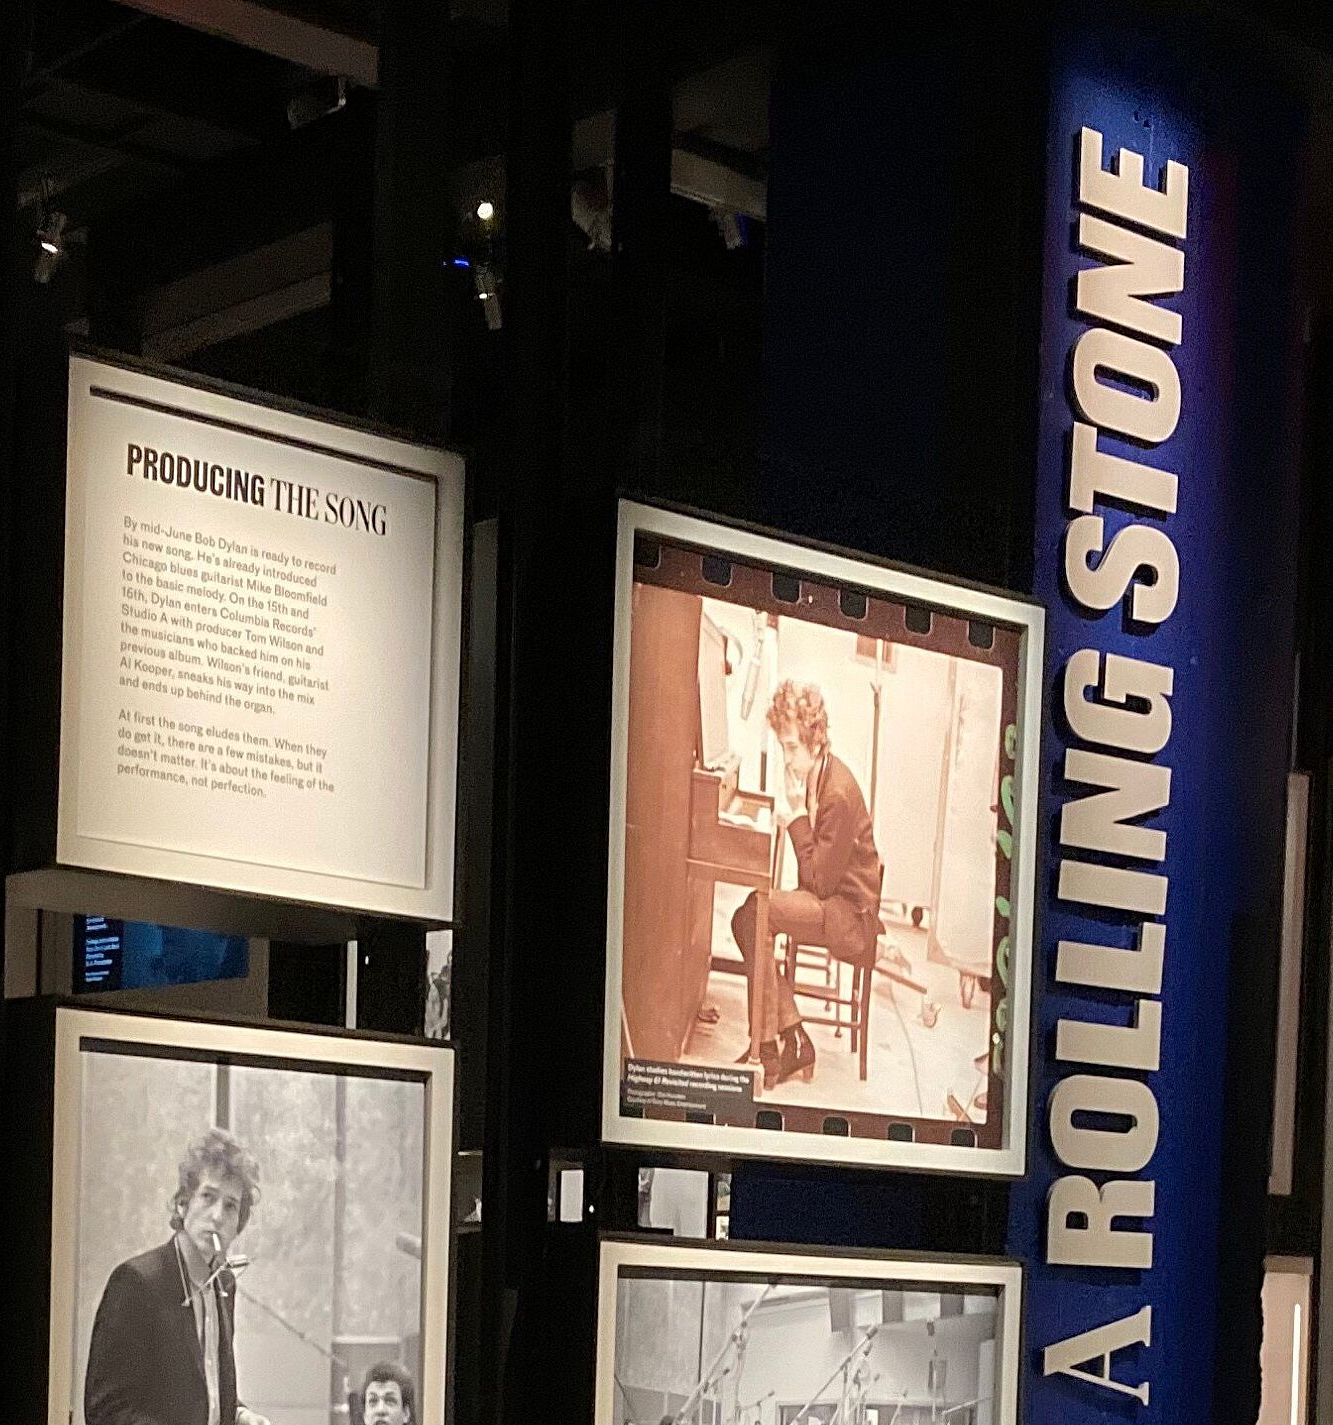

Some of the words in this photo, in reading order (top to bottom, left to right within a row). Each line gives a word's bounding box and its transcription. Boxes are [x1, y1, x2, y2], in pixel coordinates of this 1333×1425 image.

[1064, 126, 1190, 625] STONE
[126, 442, 265, 507] PRODUCING
[269, 476, 319, 521] THE
[324, 491, 387, 536] SONG
[122, 532, 139, 548] his
[141, 540, 163, 553] new
[222, 557, 260, 577] already
[262, 564, 317, 588] introduced
[123, 515, 138, 532] By
[140, 520, 192, 542] mid-June
[194, 531, 216, 548] Bob
[218, 536, 248, 555] Dylan
[249, 544, 259, 558] is
[261, 550, 289, 567] ready
[291, 555, 302, 567] to
[304, 559, 337, 575] record
[121, 568, 133, 582] to
[135, 571, 153, 586] the
[155, 575, 184, 592] basic
[228, 591, 245, 606] On
[247, 595, 264, 610] the
[266, 599, 288, 615] 15th
[290, 607, 309, 620] and
[122, 550, 167, 573] Chicago
[169, 560, 198, 578] blues
[200, 570, 244, 588] guitarist
[246, 577, 272, 594] Mike
[274, 583, 328, 607] Bloomfield
[121, 603, 157, 622] Studio
[159, 611, 168, 624] A
[170, 615, 193, 629] with
[195, 621, 242, 639] producer
[244, 628, 267, 645] Tom
[268, 634, 303, 652] Wilson
[305, 644, 324, 657] and
[150, 591, 181, 609] Dylan
[183, 601, 218, 617] enters
[219, 606, 270, 628] Columbia
[119, 640, 166, 659] previous
[287, 674, 330, 691] guitarist
[120, 620, 139, 636] the
[140, 627, 194, 647] musicians
[196, 638, 218, 652] who
[220, 641, 257, 660] backed
[259, 649, 279, 664] him
[280, 656, 293, 667] on
[296, 656, 311, 671] his
[119, 655, 131, 669] Al
[177, 670, 214, 685] sneaks
[216, 674, 232, 689] his
[233, 681, 254, 696] way
[256, 682, 276, 698] into
[278, 687, 295, 701] the
[296, 693, 315, 706] mix
[119, 675, 139, 688] and
[141, 680, 168, 694] ends
[170, 686, 184, 699] up
[186, 686, 222, 704] behind
[224, 694, 242, 708] the
[117, 708, 131, 722] At
[133, 710, 155, 727] first
[158, 716, 176, 730] the
[178, 722, 204, 738] song
[205, 724, 240, 742] eludes
[273, 736, 303, 754] When
[305, 743, 327, 760] they
[117, 726, 132, 740] do
[133, 731, 151, 743] get
[167, 735, 195, 751] there
[197, 743, 215, 754] are
[217, 746, 223, 756] a
[225, 745, 244, 759] few
[296, 757, 313, 772] but
[315, 761, 323, 774] it
[191, 775, 208, 788] not
[218, 762, 248, 777] about
[251, 767, 268, 781] the
[270, 769, 304, 790] feeling
[306, 777, 316, 789] of
[318, 779, 335, 793] the
[1047, 648, 1175, 1267] ROLLING
[1044, 1305, 1151, 1406] A
